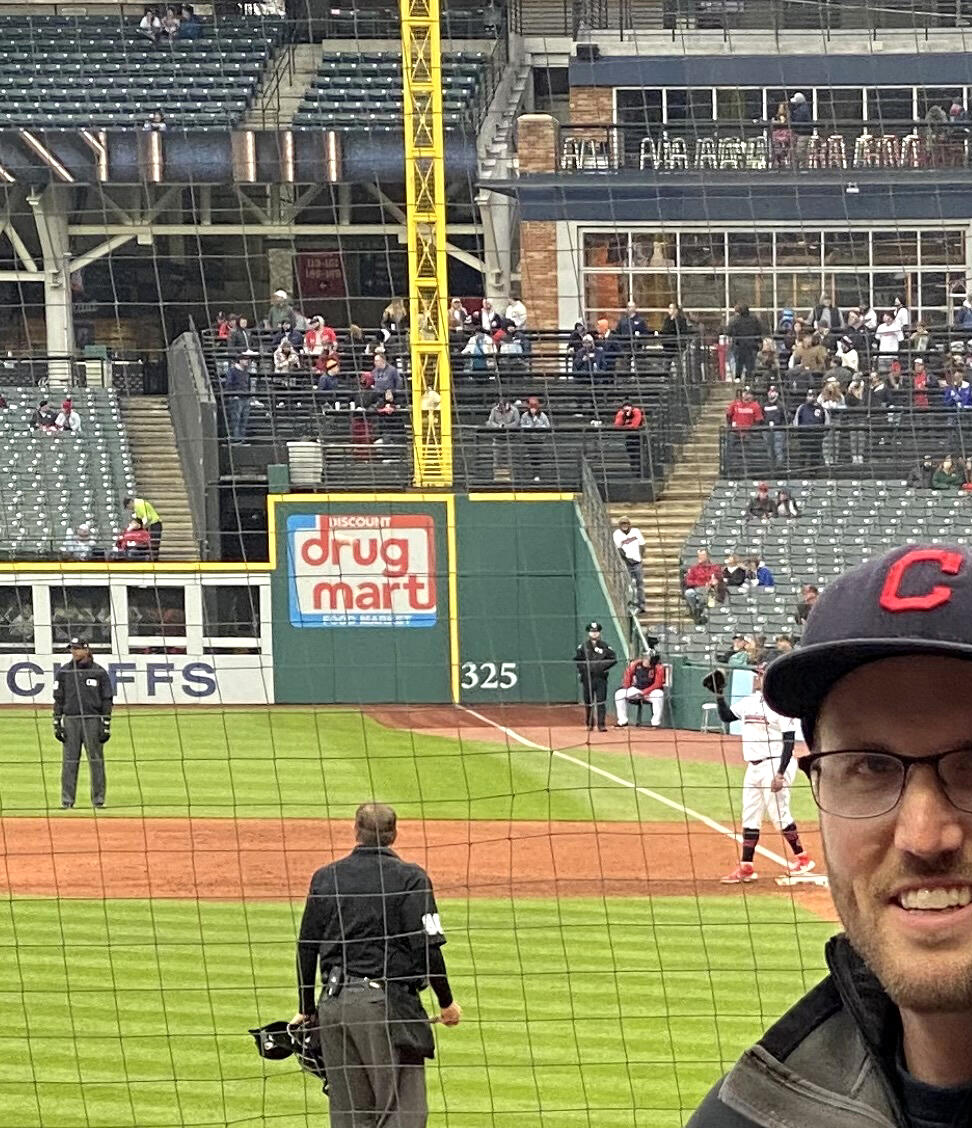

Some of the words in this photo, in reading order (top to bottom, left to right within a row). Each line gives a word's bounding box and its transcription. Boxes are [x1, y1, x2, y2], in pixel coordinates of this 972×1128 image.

[328, 516, 392, 528] DISCOUNT
[301, 518, 409, 577] drug
[312, 574, 436, 611] mart
[879, 548, 965, 613] C
[6, 661, 217, 697] CFFS
[461, 661, 518, 689] 325
